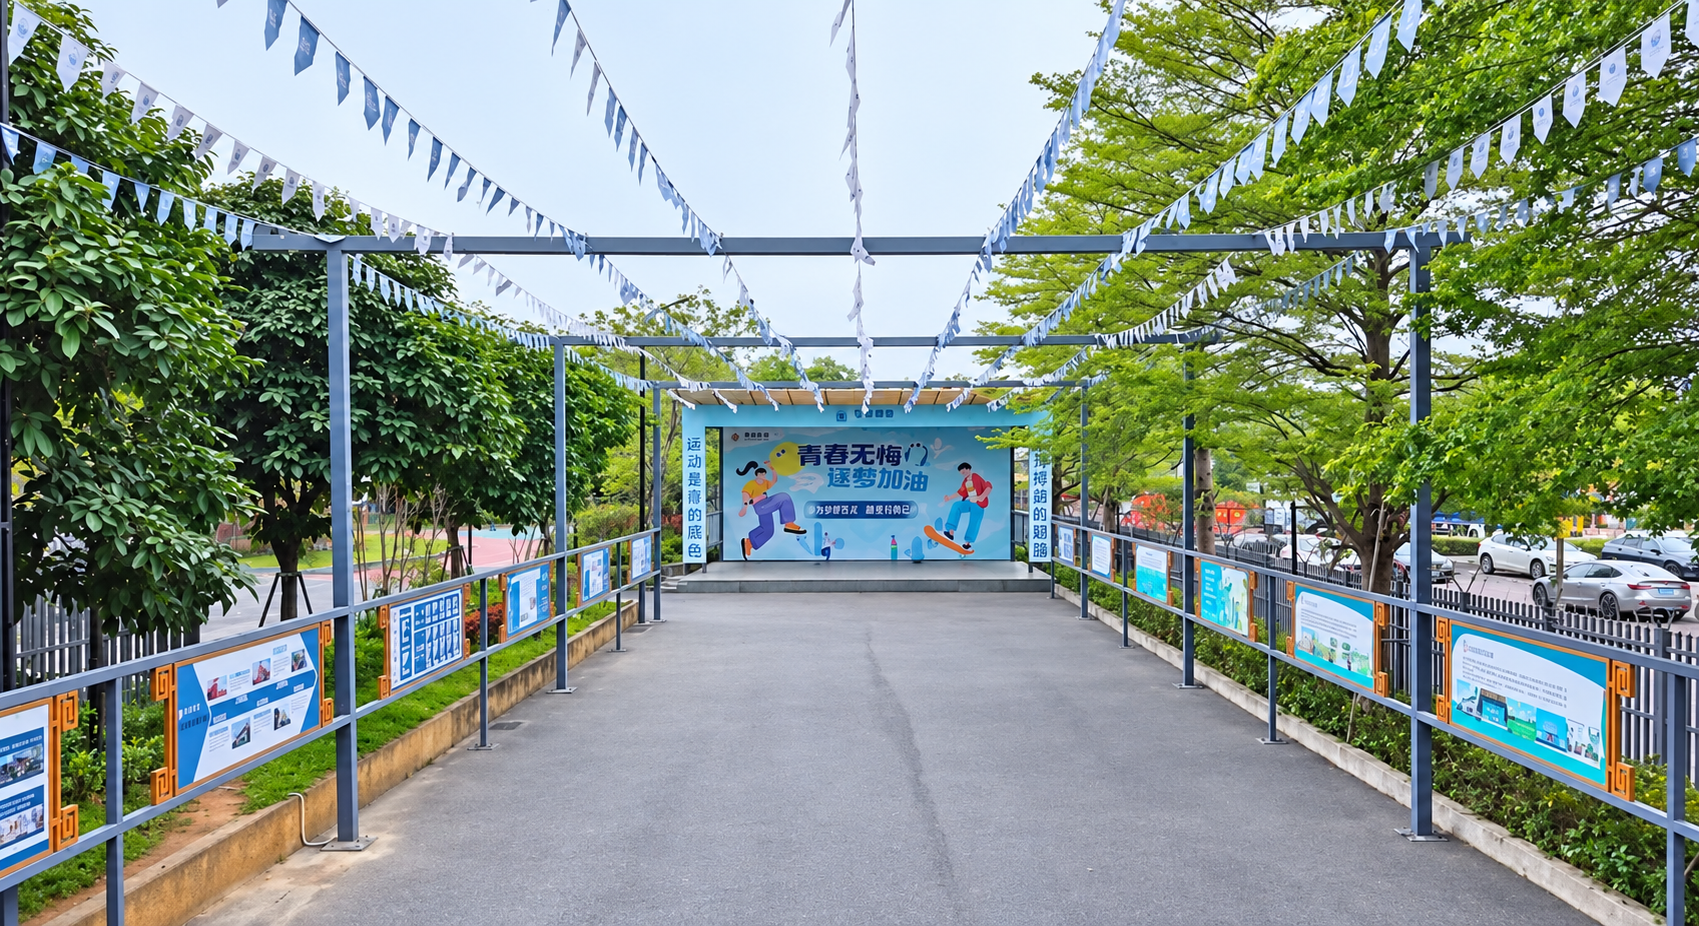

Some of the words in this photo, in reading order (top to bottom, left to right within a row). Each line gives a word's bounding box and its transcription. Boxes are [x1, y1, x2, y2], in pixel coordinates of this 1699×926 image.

[797, 443, 902, 467] 青春无悔
[827, 467, 929, 492] 逐梦加油
